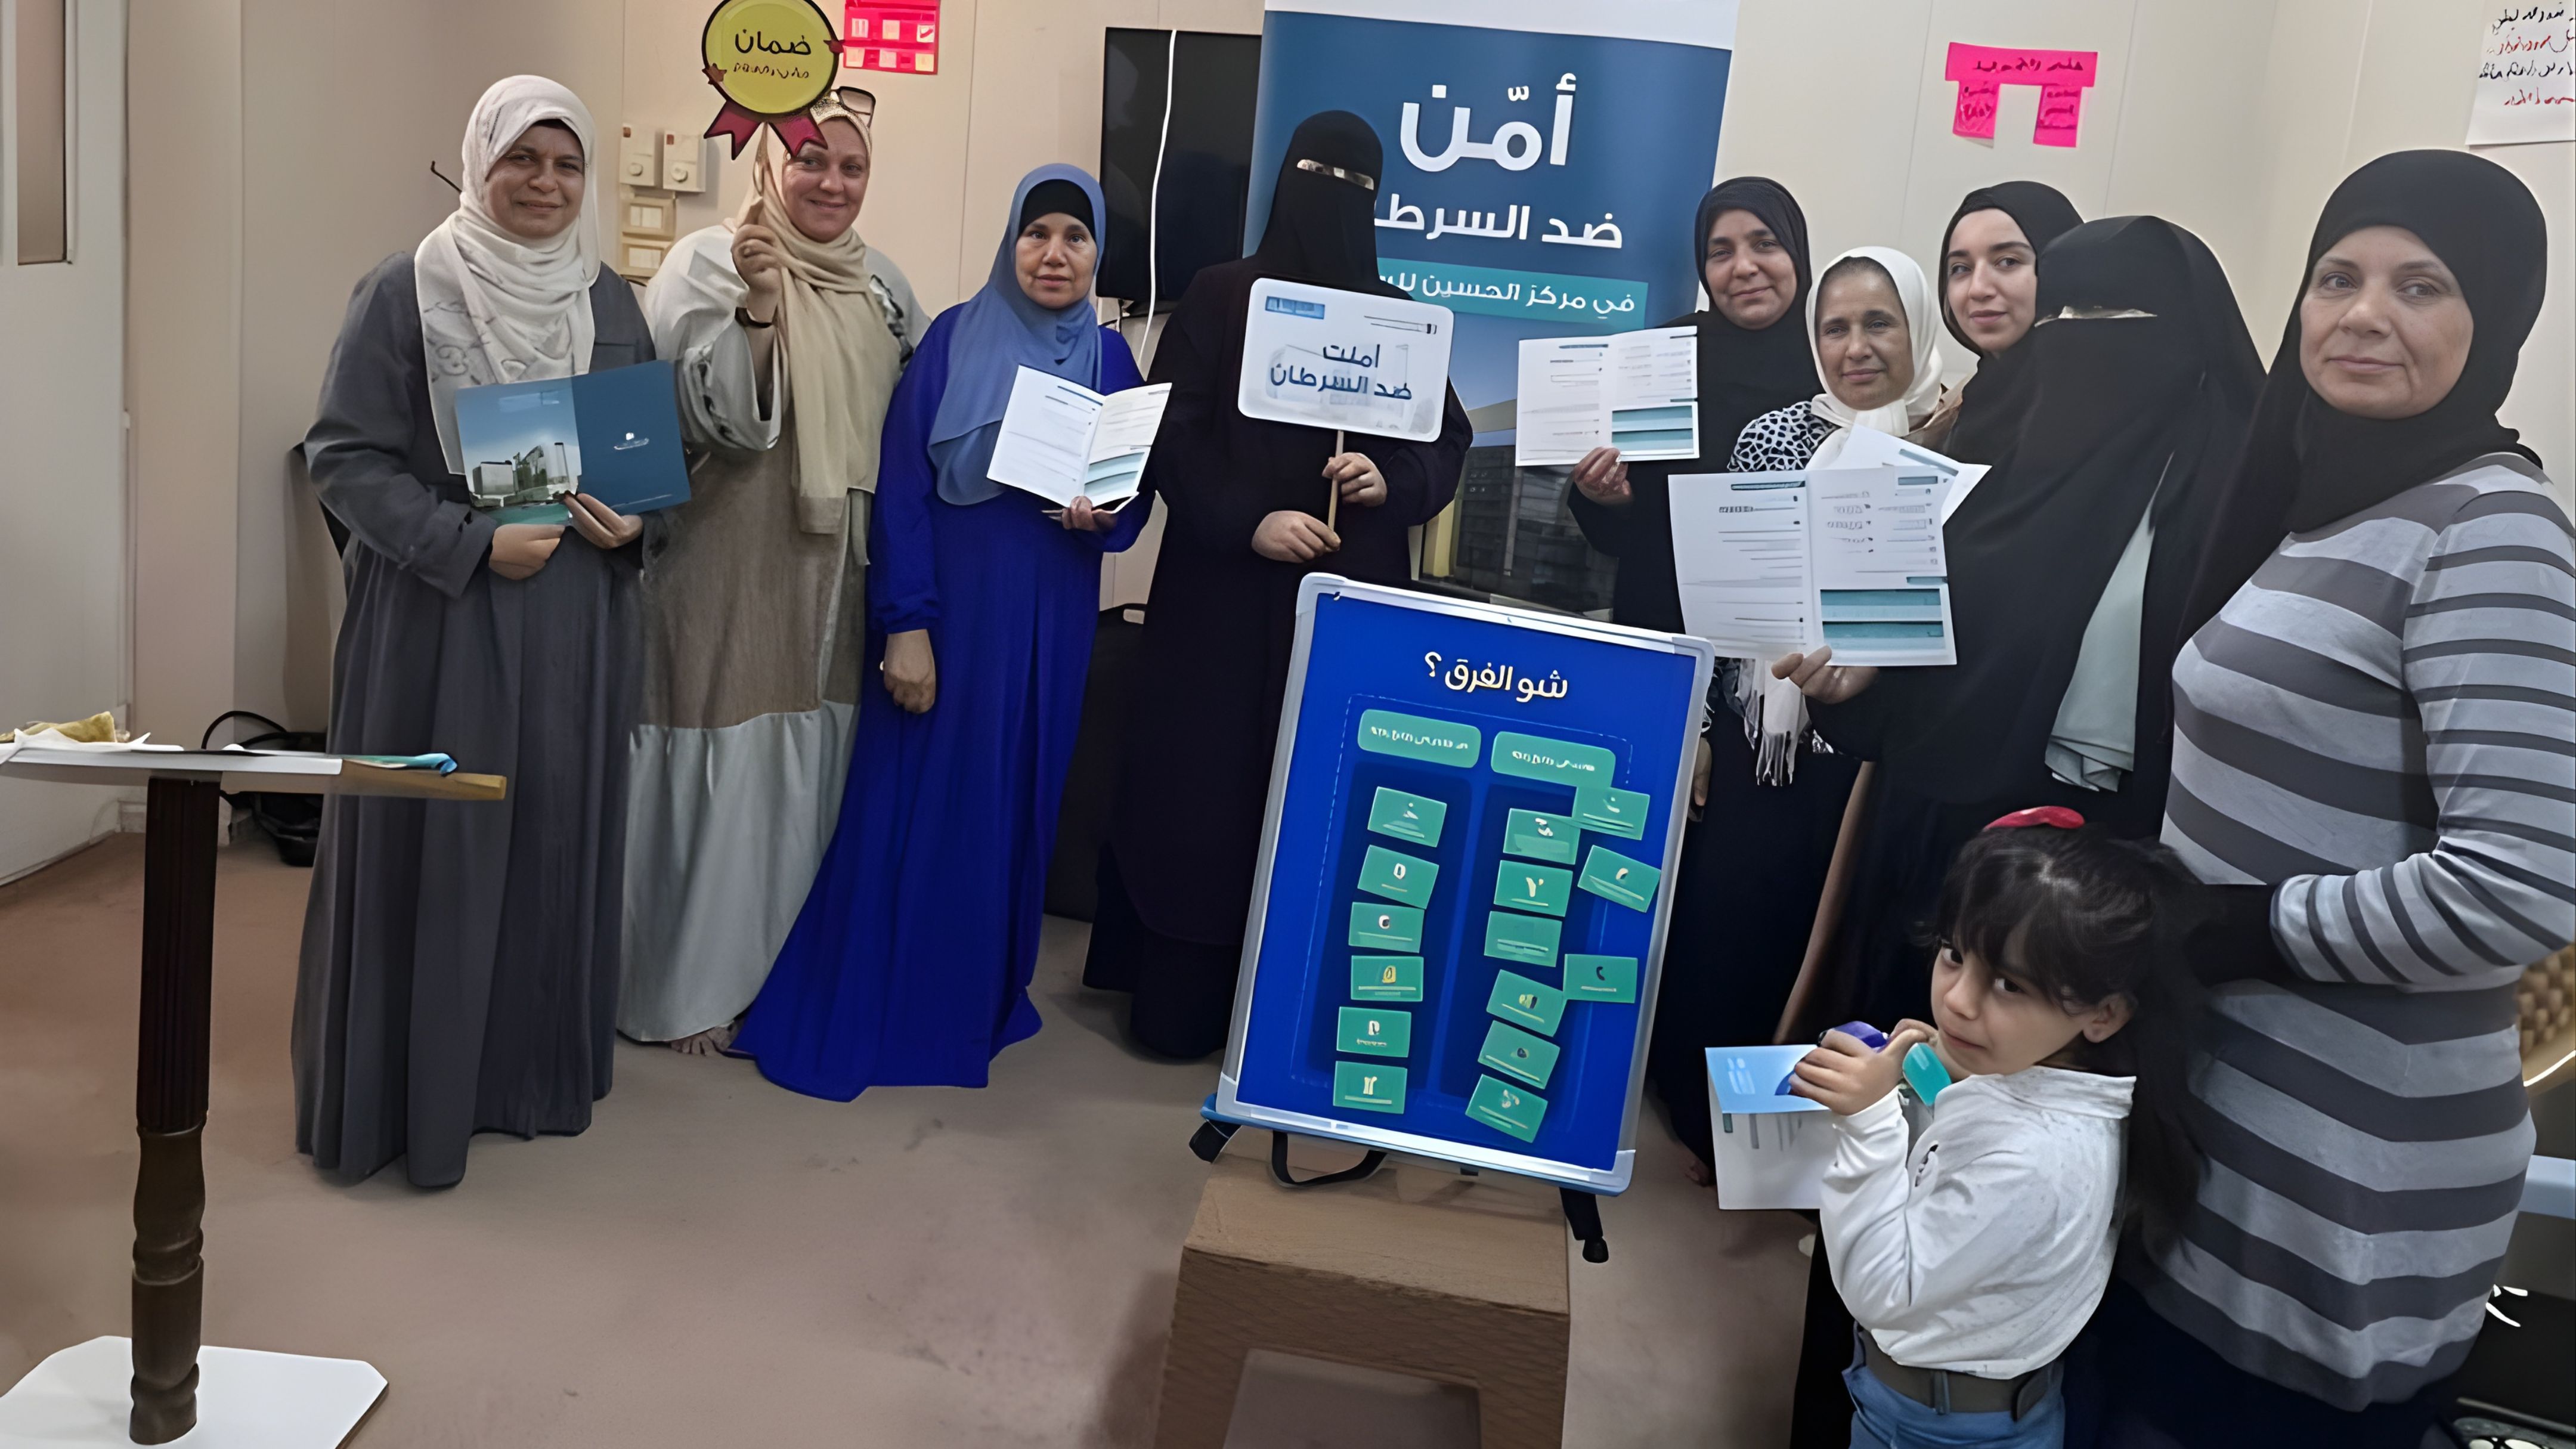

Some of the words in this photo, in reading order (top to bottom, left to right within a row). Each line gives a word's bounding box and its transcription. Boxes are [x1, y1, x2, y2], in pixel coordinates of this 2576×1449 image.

[735, 29, 812, 55] ضمان
[1374, 193, 1531, 240] السرط
[1541, 213, 1623, 249] ضد
[1422, 275, 1521, 301] الحسين
[1526, 283, 1587, 309] مركز
[1593, 294, 1635, 320] في
[1270, 364, 1369, 394] السرطان
[1374, 382, 1413, 400] ضد
[1444, 658, 1514, 693] الفرق
[1516, 669, 1568, 703] شو
